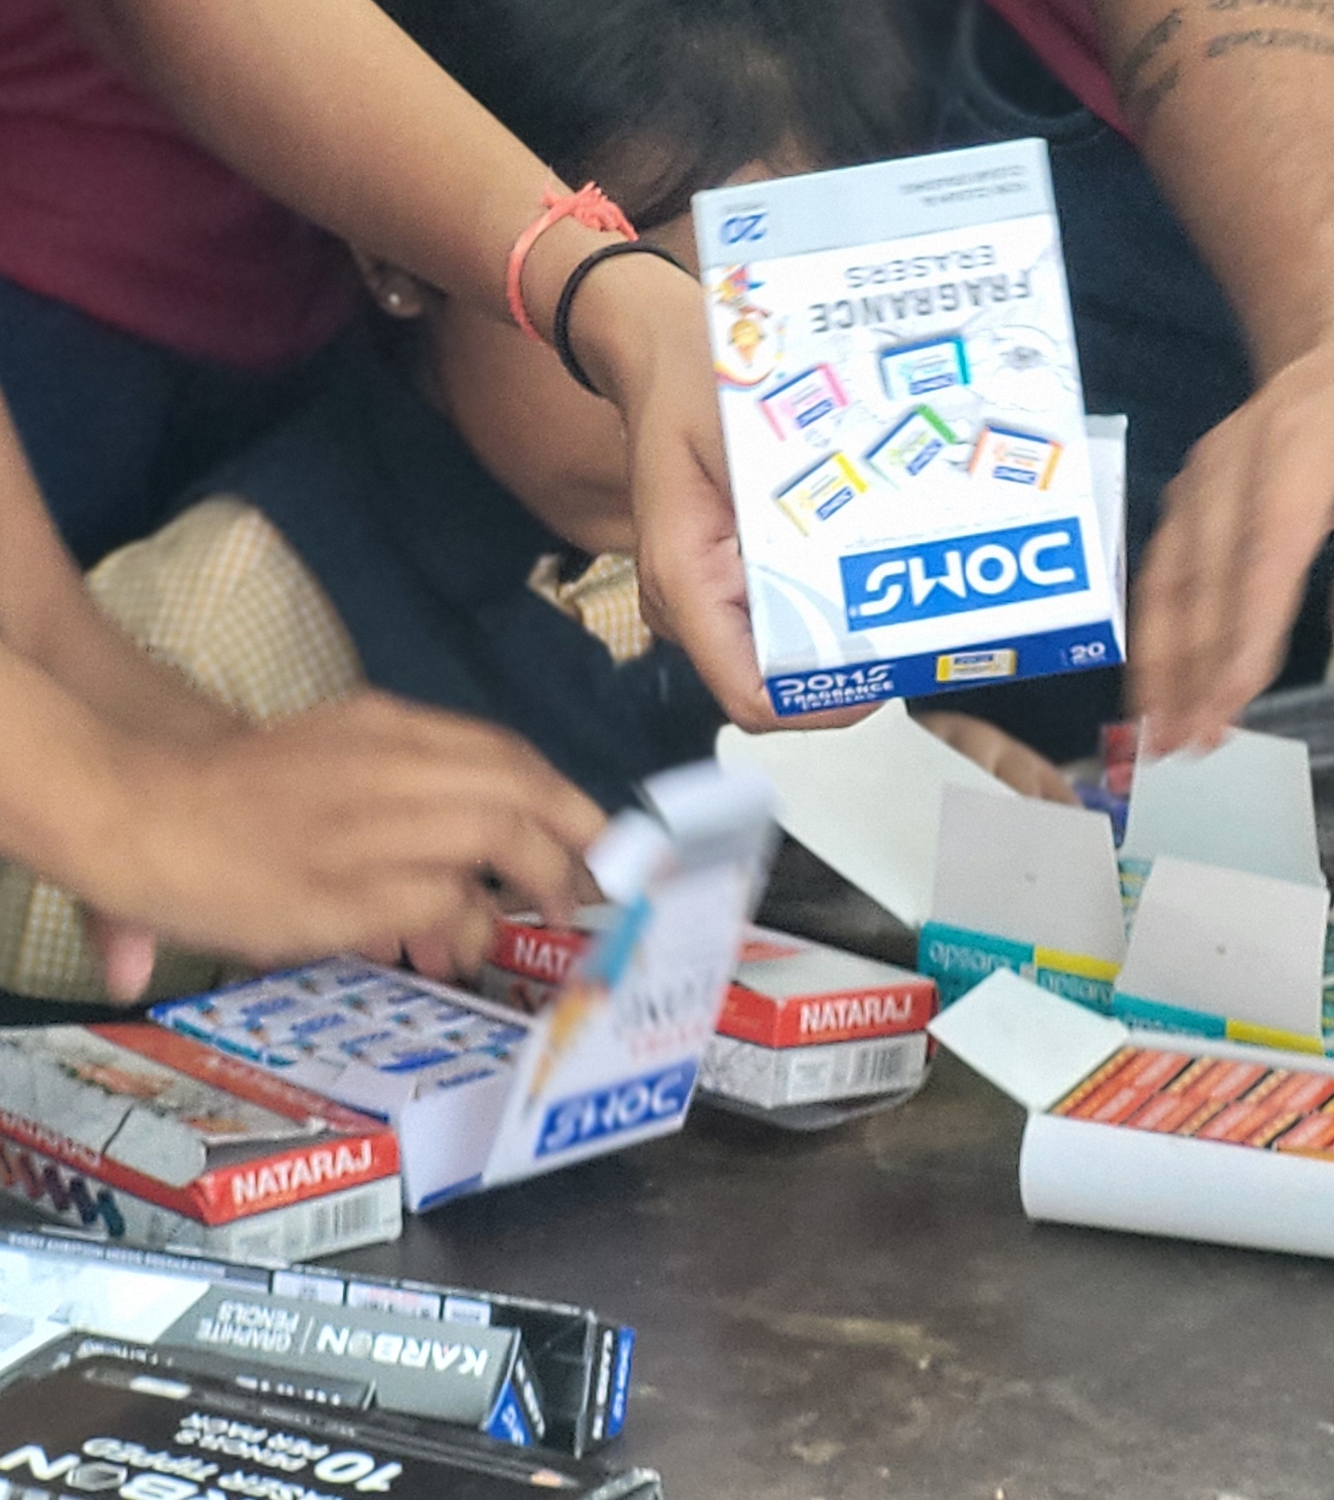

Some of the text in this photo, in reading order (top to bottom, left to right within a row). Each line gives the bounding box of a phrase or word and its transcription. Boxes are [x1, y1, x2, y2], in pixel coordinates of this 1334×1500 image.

[720, 211, 768, 244] 20
[844, 244, 997, 287] ERASERS
[810, 270, 1034, 334] FRAGRANCE
[859, 531, 1077, 619] DOMS
[1069, 641, 1106, 662] 20
[774, 664, 896, 694] DOMS
[781, 679, 895, 706] FRAGRANCE
[799, 994, 914, 1037] NATARAJ
[231, 1143, 374, 1204] NATARAJ
[196, 1316, 293, 1353] GRAPHITE
[218, 1300, 300, 1332] PENCILS
[316, 1323, 489, 1377] KARBON
[80, 1436, 219, 1483] TIPPED
[313, 1450, 404, 1492] 10
